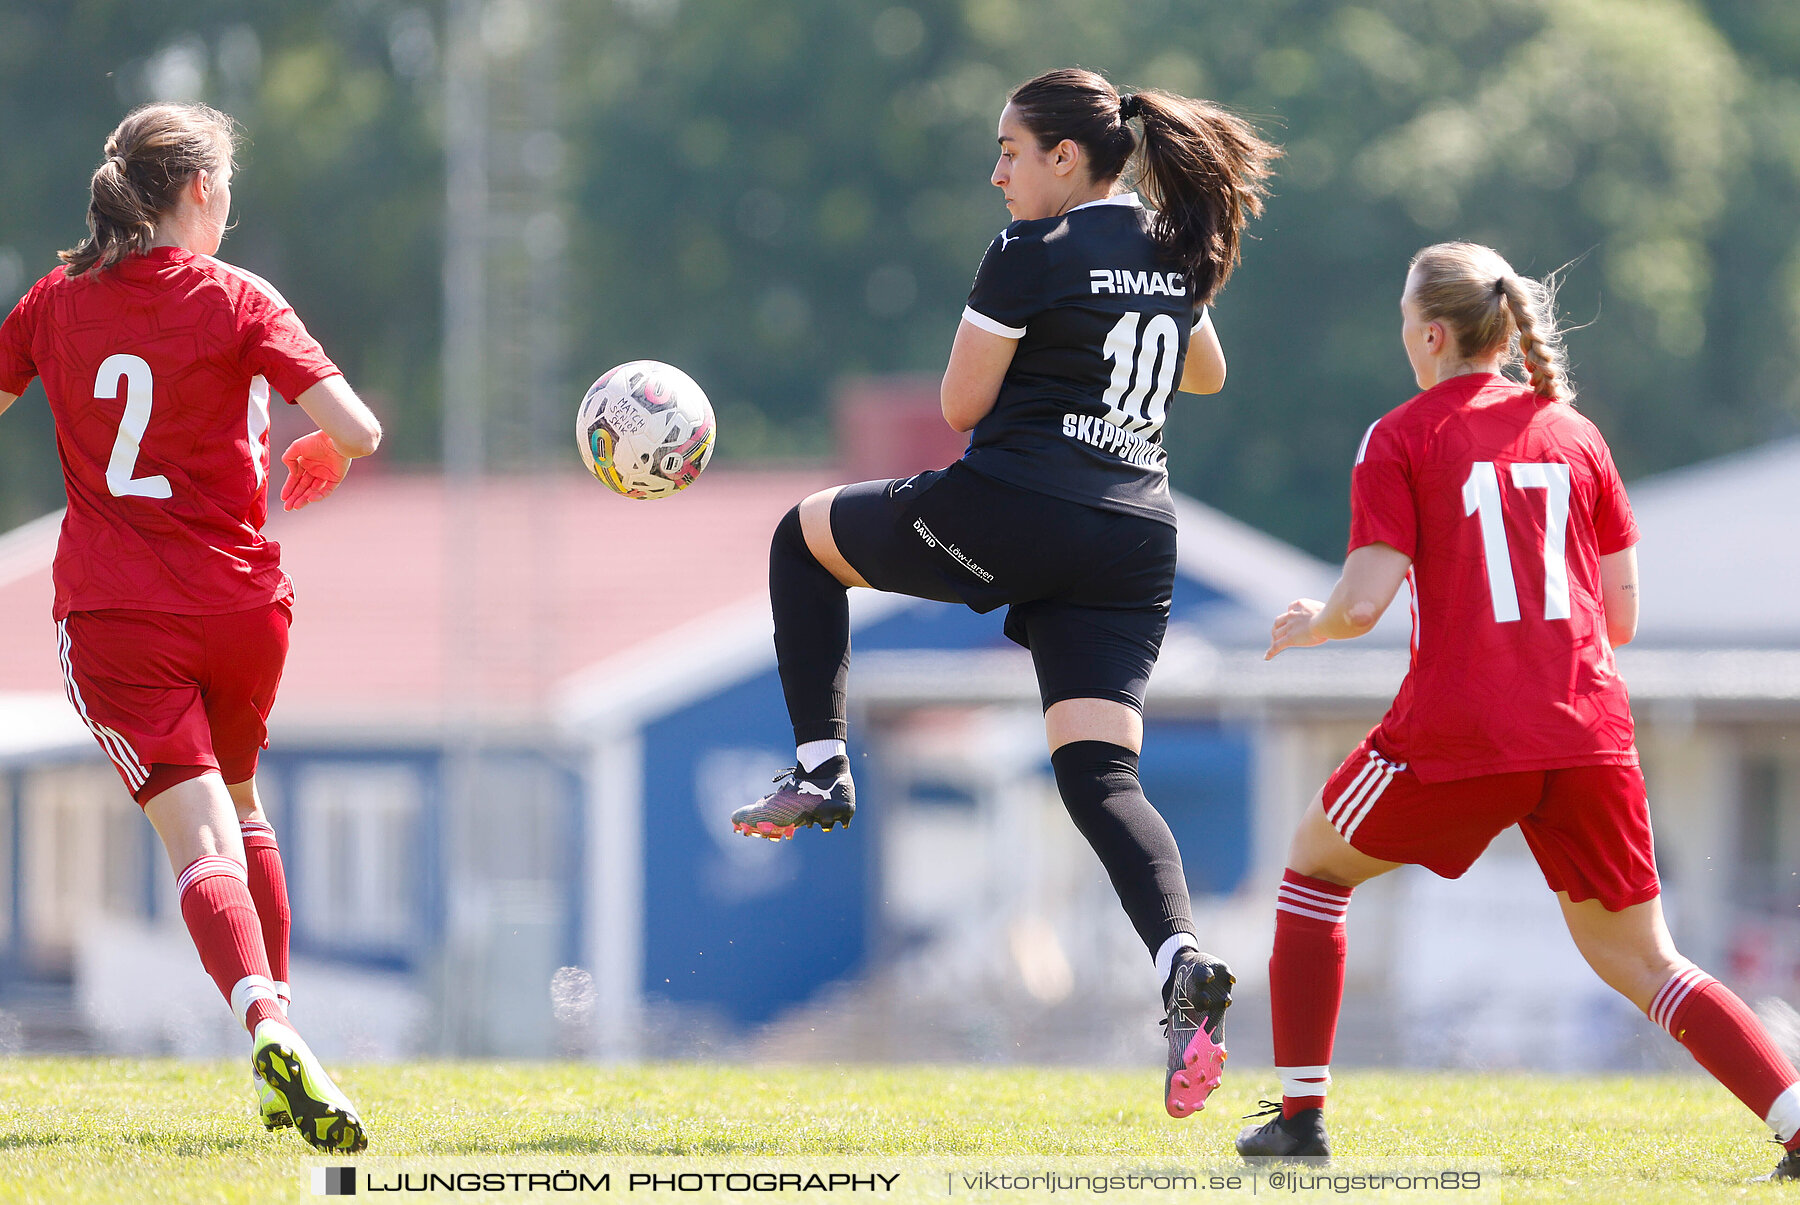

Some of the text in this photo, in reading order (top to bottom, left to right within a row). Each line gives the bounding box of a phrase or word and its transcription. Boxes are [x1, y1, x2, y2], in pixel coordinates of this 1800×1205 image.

[1102, 311, 1179, 440] 10
[93, 353, 173, 499] 2
[609, 416, 628, 436] SKIK
[610, 405, 638, 434] SENIOR
[617, 397, 645, 428] MATCH
[912, 520, 936, 548] DAVID
[1462, 461, 1571, 623] 17
[948, 543, 994, 581] Löw-Larsen
